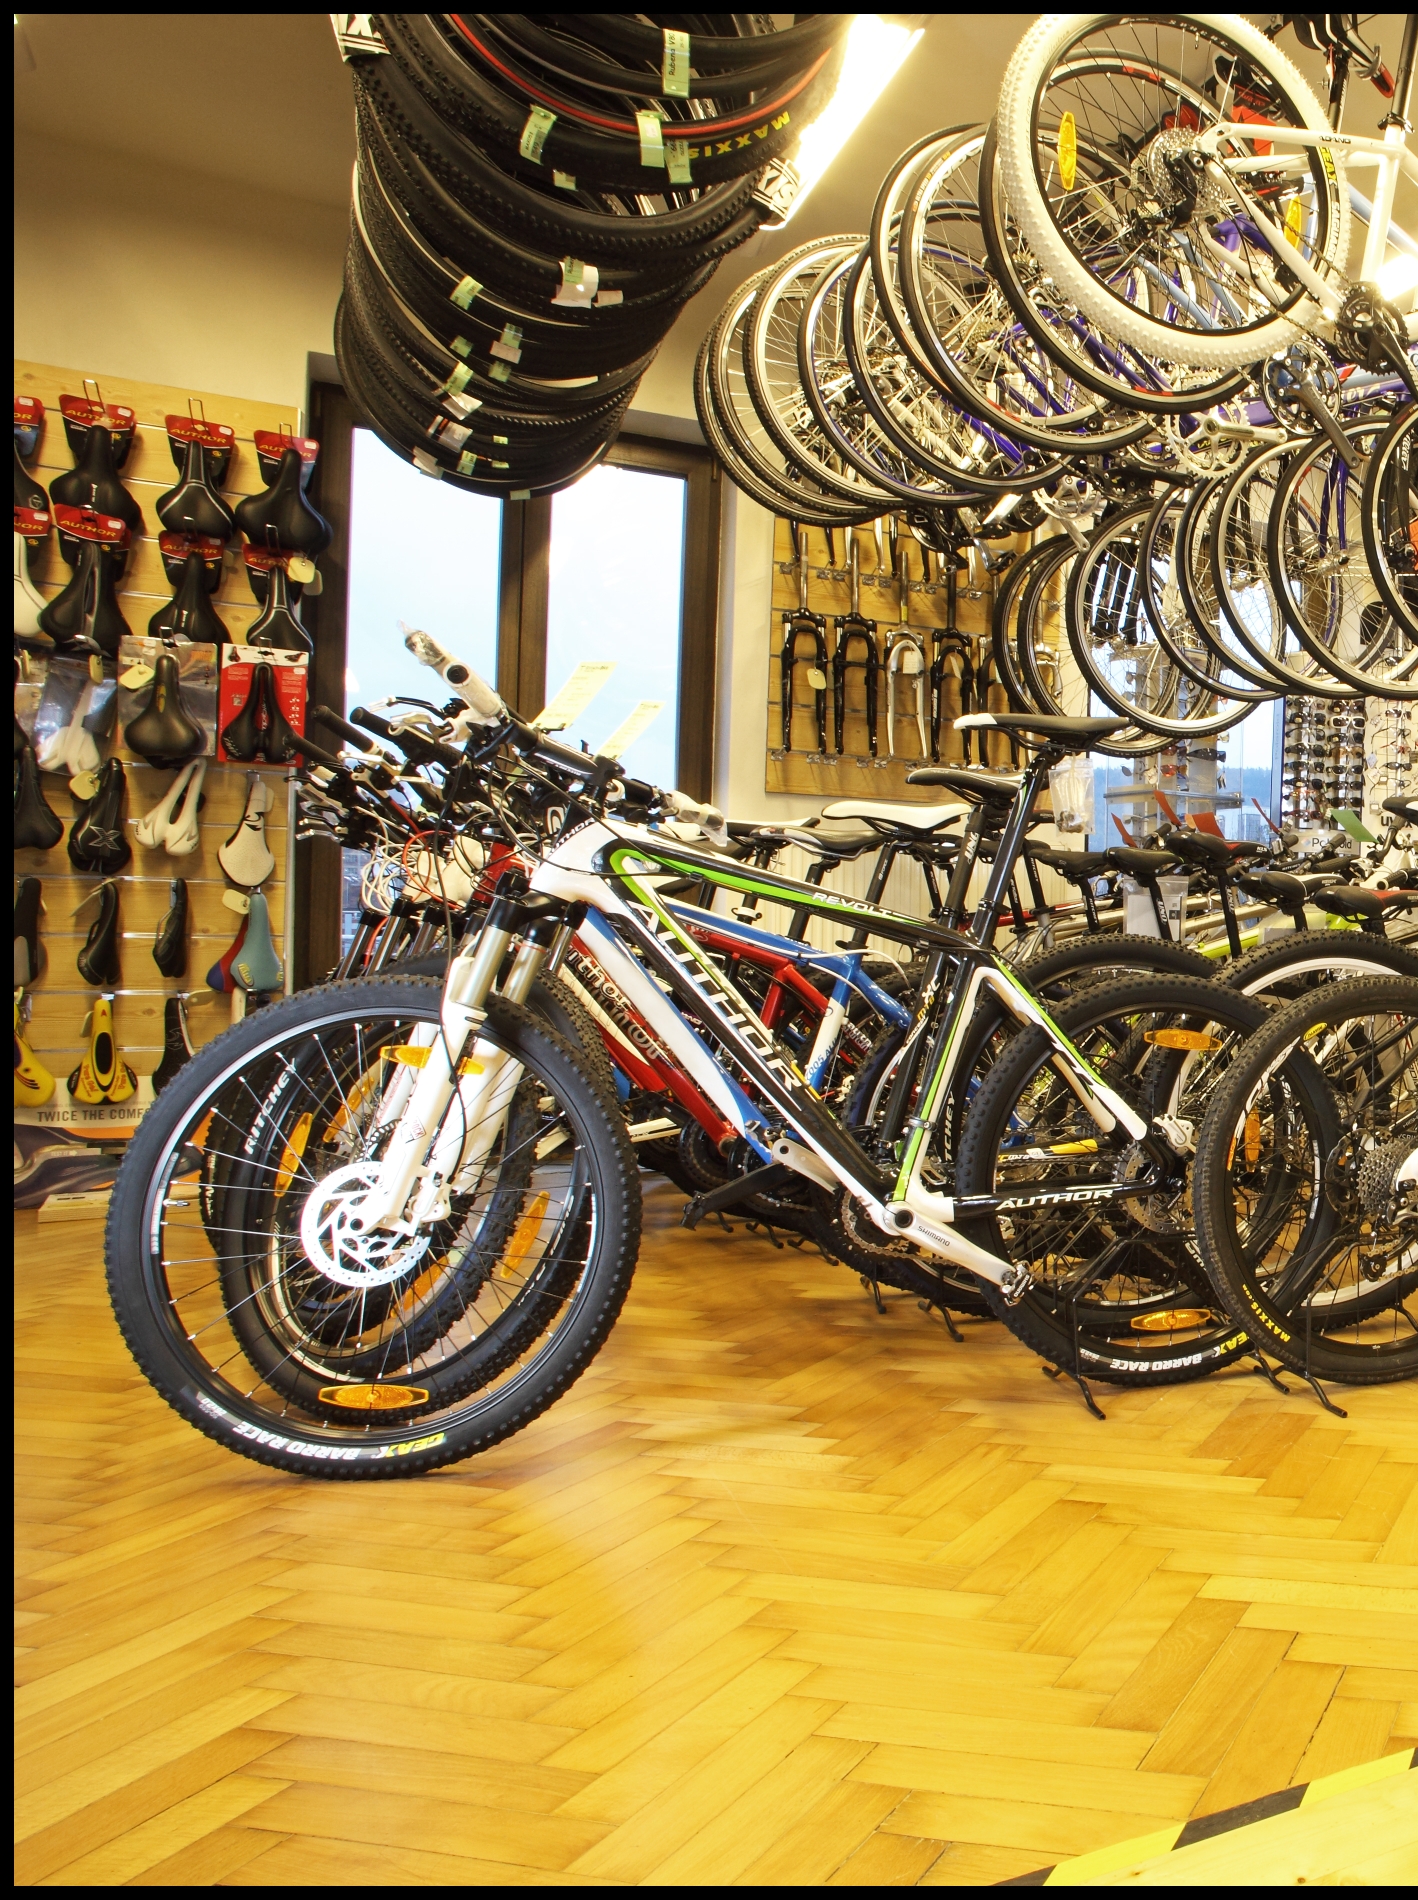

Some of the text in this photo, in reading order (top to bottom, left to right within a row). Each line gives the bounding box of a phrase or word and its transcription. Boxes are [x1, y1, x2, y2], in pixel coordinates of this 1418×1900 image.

[668, 48, 676, 77] Rubena
[689, 111, 791, 159] MAXXIS
[1326, 201, 1341, 263] SAGUARO
[65, 408, 127, 427] AUTHOR
[171, 427, 227, 445] AUTHOR
[60, 518, 117, 538] AUTHOR
[163, 542, 218, 556] AUTHOR
[811, 891, 893, 918] REVOLT
[626, 900, 802, 1091] AUTHOR
[37, 1110, 78, 1122] TWICE
[82, 1109, 105, 1120] THE
[243, 1057, 299, 1155] RITCHEY
[995, 1188, 1114, 1211] AUTHOR
[917, 1224, 951, 1248] SHIMANO
[1219, 1331, 1250, 1357] EAX
[1110, 1353, 1202, 1372] BARRO RACE
[232, 1420, 446, 1461] GEAX BARRO RACE
